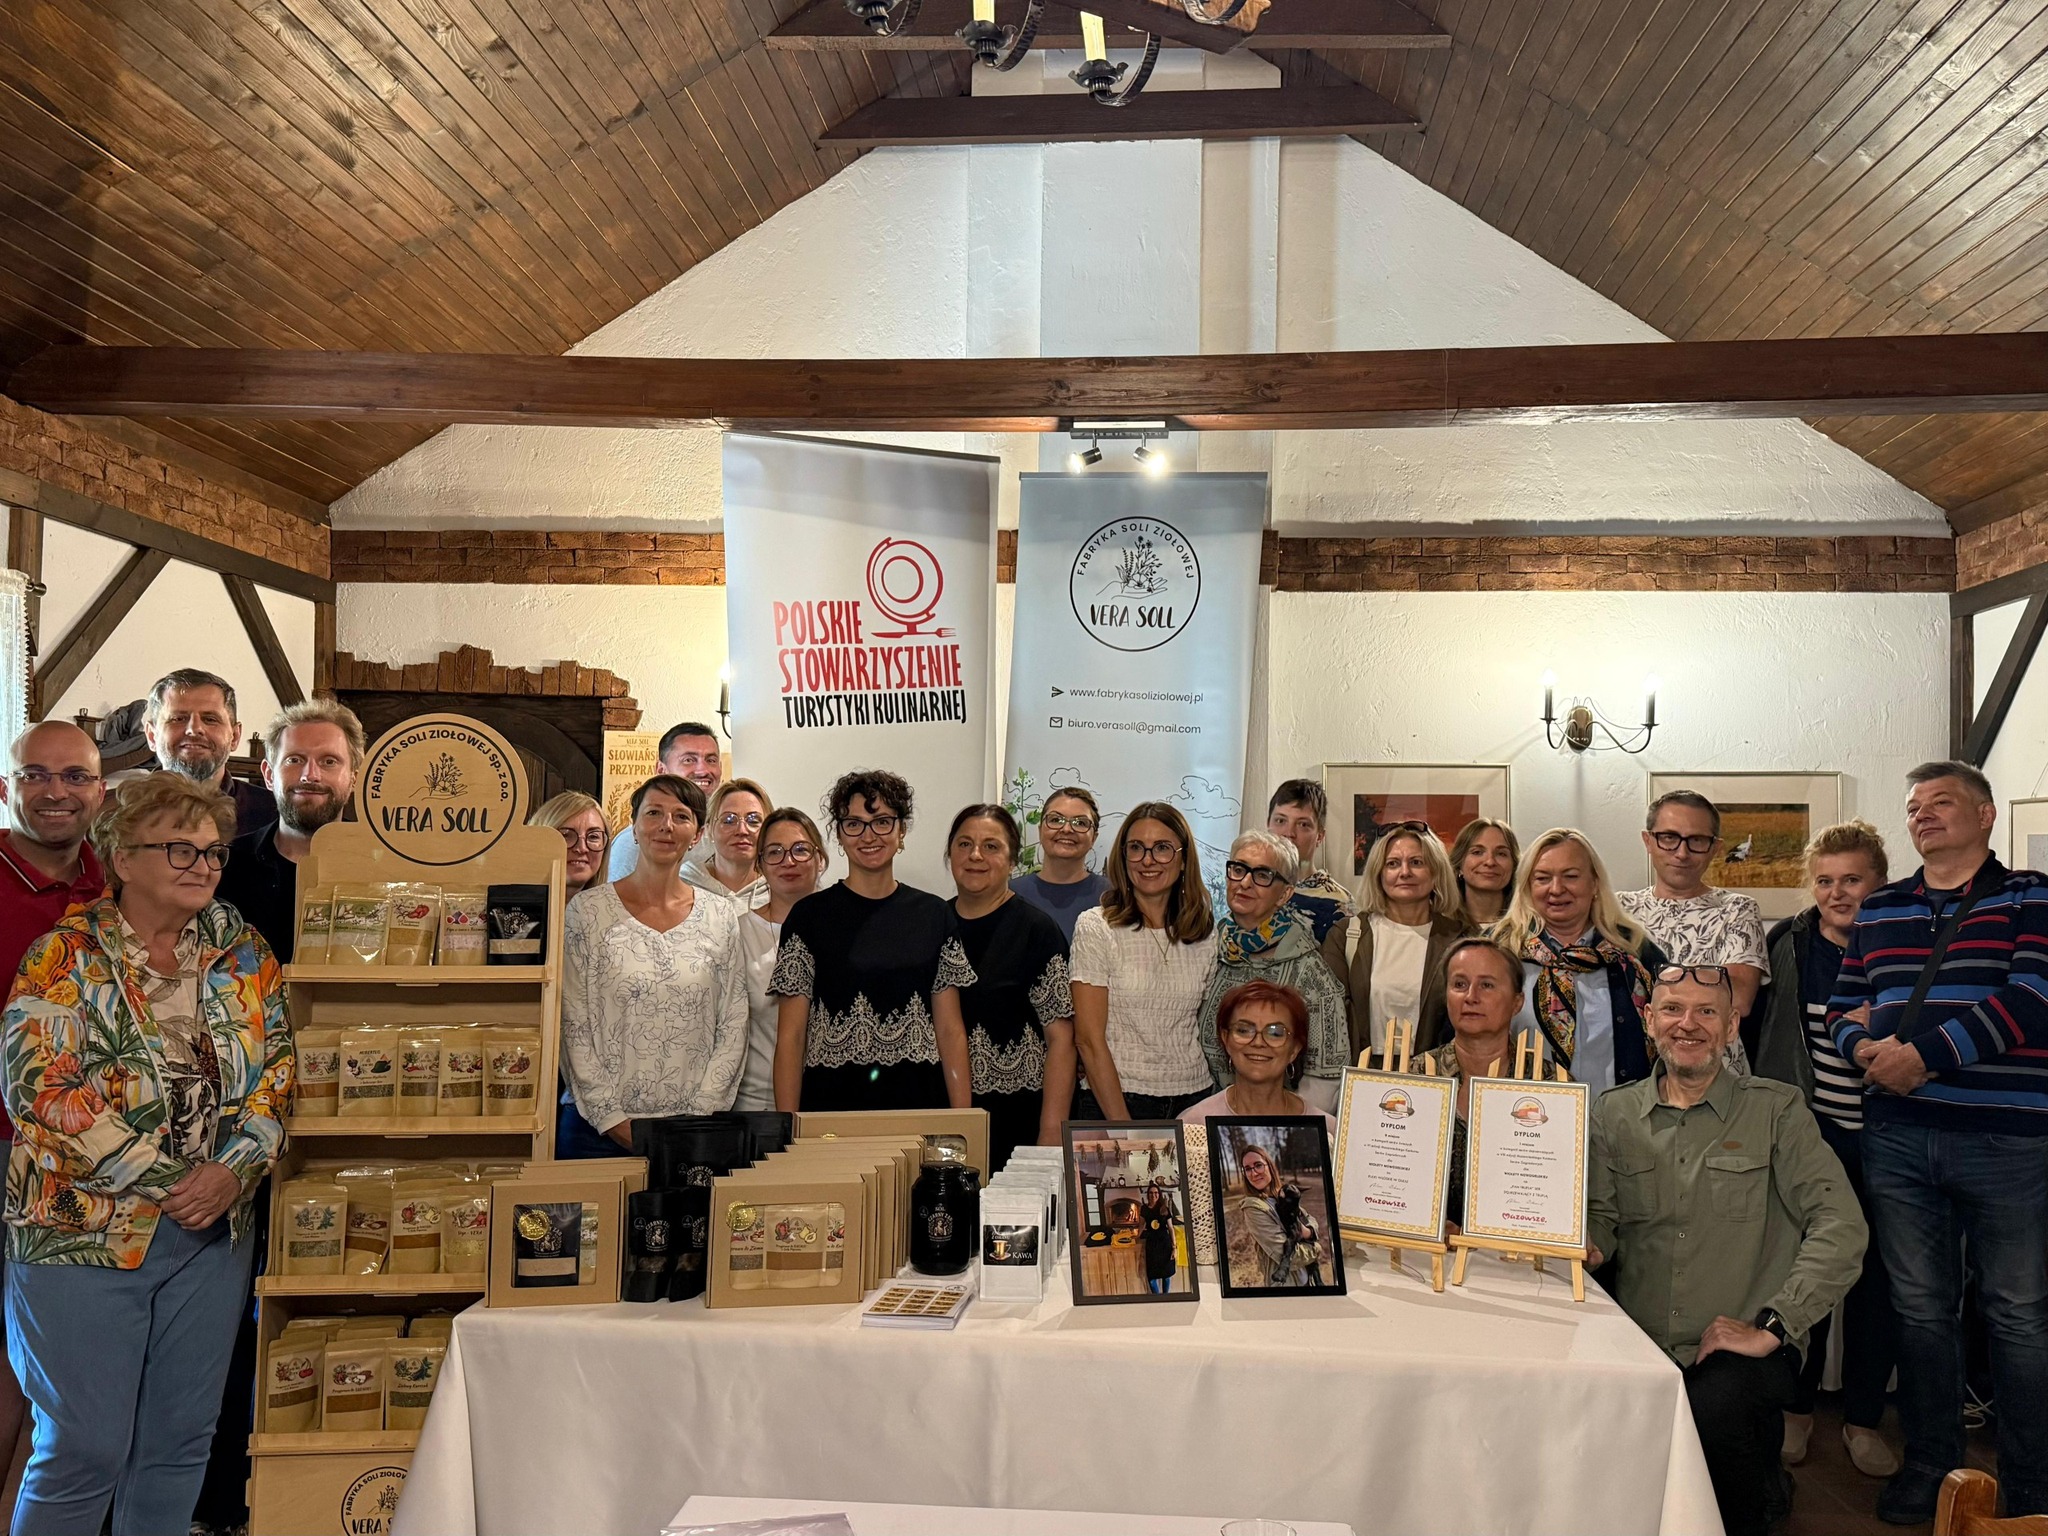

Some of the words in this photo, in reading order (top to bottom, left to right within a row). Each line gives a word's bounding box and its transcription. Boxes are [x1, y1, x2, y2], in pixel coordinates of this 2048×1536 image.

[1077, 529, 1117, 576] FABRYKA
[1121, 523, 1149, 533] SOLI
[1153, 526, 1194, 579] ZIOŁOWEJ
[773, 601, 863, 645] POLSKIE
[1090, 604, 1129, 627] VERA
[1135, 605, 1175, 629] SOLL
[778, 644, 962, 693] STOWARZYSZENIE
[782, 693, 870, 728] TURYSTYKI
[873, 689, 966, 724] KULINARNEJ
[1069, 688, 1204, 704] www.fabrykasoliziolowej.pl
[1068, 718, 1201, 734] biuro.verasoll@gmail.com
[371, 747, 401, 799] FABRYKA
[400, 731, 427, 749] SOLI
[429, 730, 491, 755] ZIOŁOWEJ
[382, 805, 433, 832] VERA
[441, 807, 492, 833] SOLL
[1380, 1122, 1406, 1130] DYPLOM
[1012, 1251, 1032, 1259] KAWA
[346, 1483, 364, 1515] FABRYKA
[363, 1473, 379, 1485] SOLI
[352, 1518, 382, 1535] VERA
